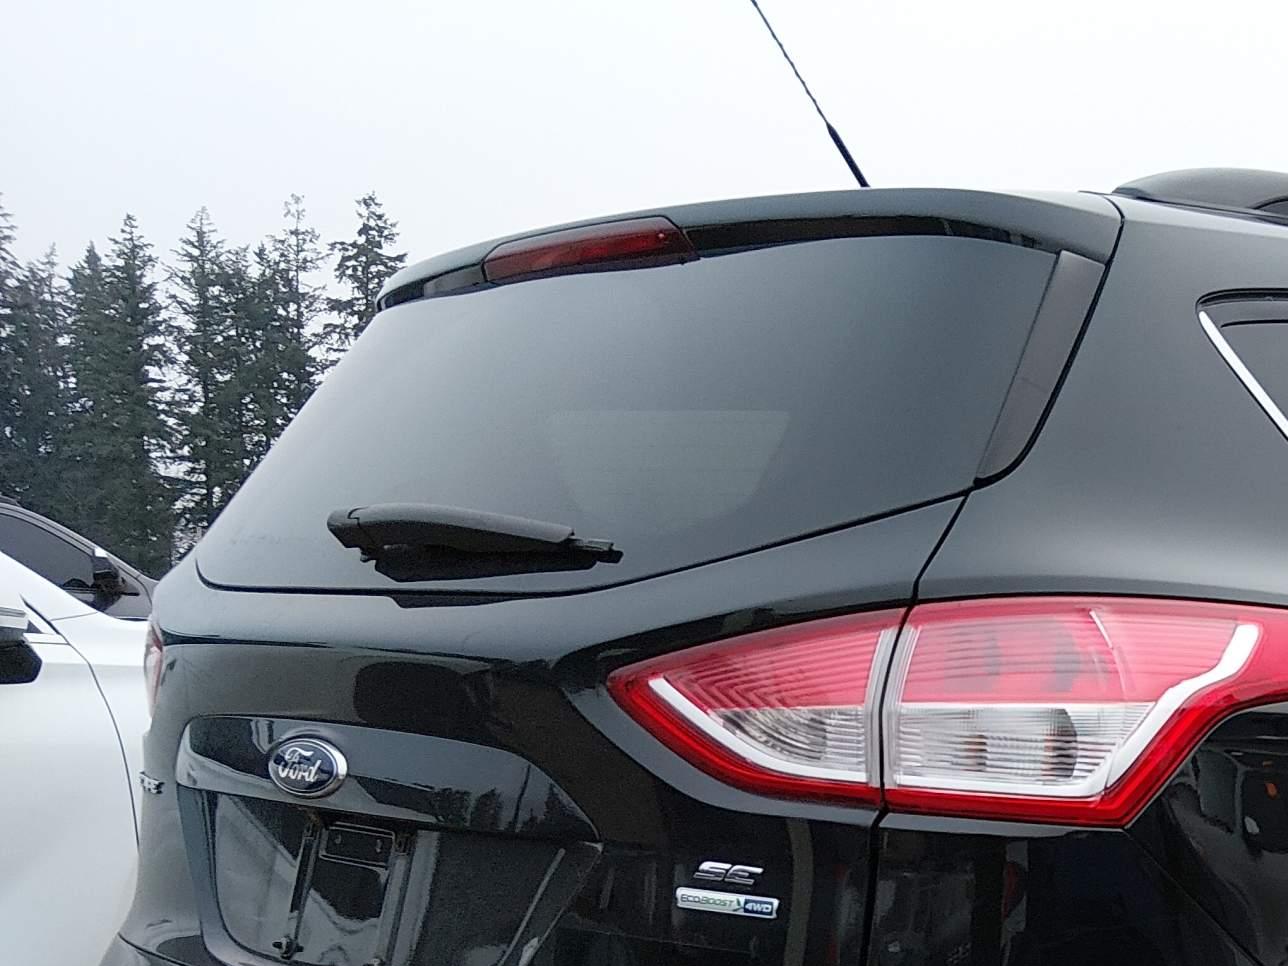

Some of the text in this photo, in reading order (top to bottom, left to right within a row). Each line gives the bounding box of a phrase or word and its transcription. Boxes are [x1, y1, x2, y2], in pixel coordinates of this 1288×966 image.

[278, 746, 322, 783] Ford
[693, 861, 764, 885] SE
[744, 901, 773, 914] 4WD
